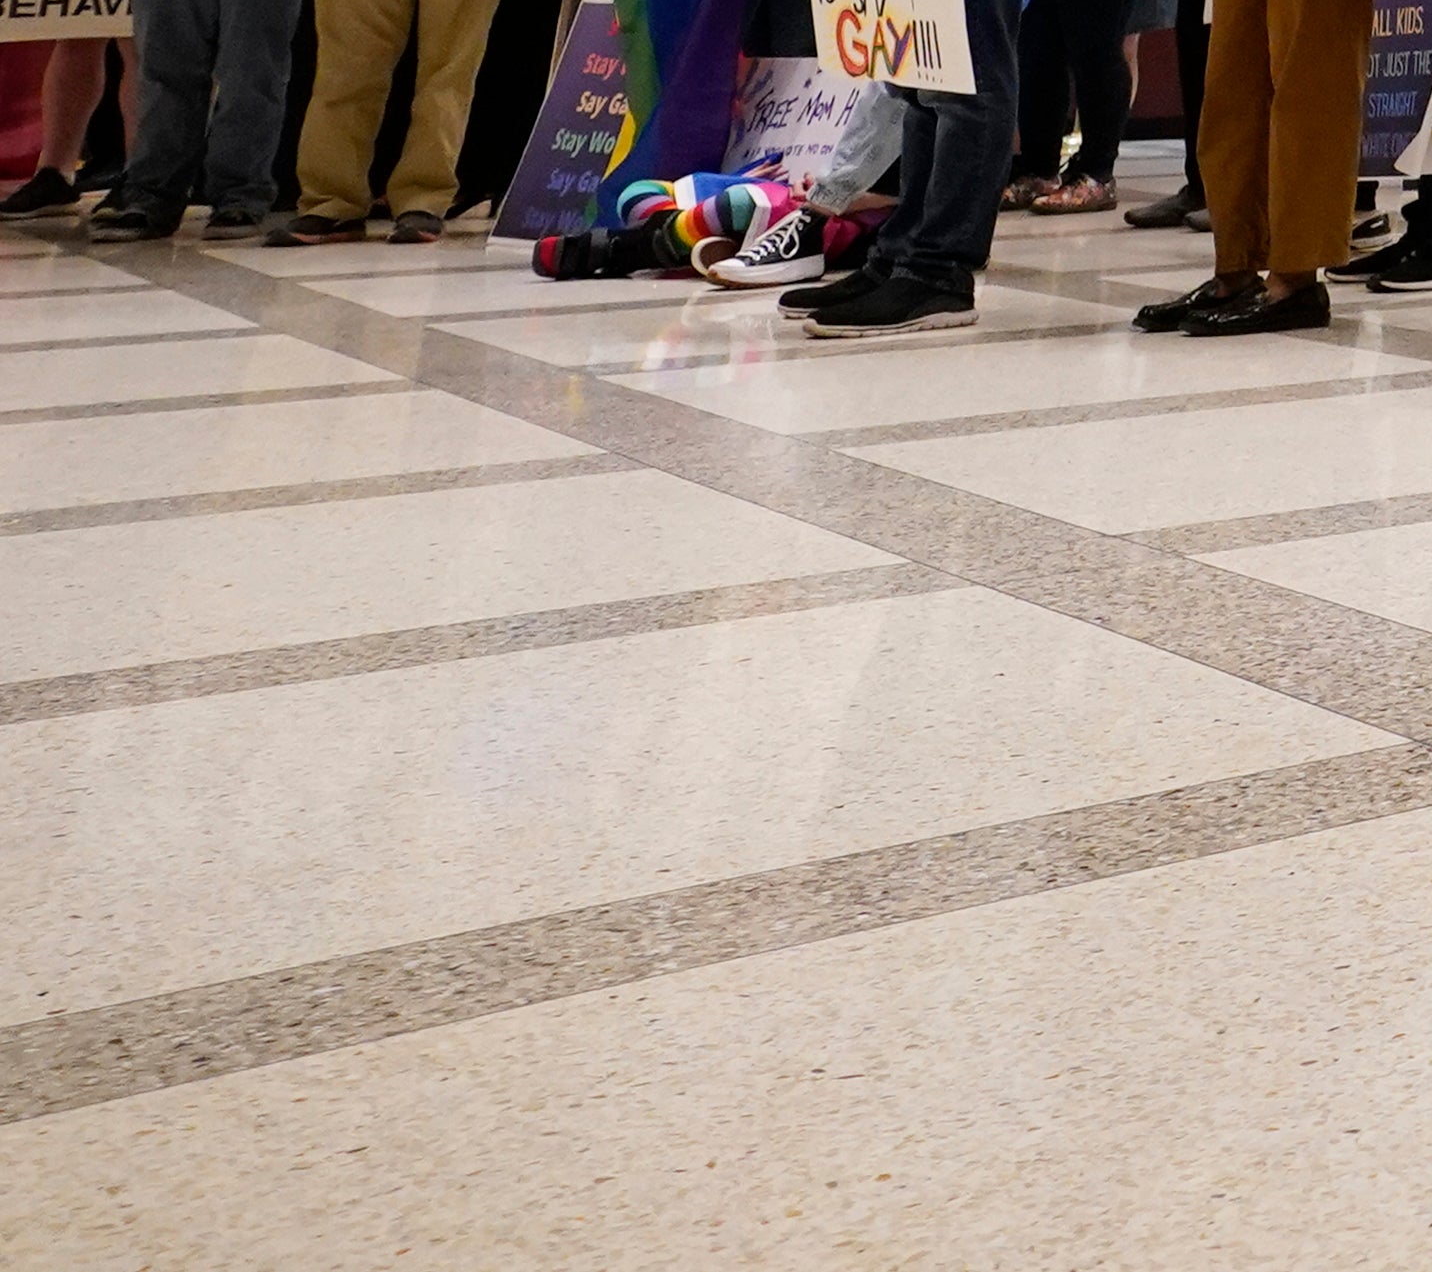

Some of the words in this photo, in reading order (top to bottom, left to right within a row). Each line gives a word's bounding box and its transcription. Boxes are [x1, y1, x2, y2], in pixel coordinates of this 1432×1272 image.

[1372, 9, 1392, 37] ALL
[583, 53, 620, 81] Stay
[1383, 50, 1411, 77] JUST
[576, 91, 607, 119] Say
[747, 88, 799, 133] FREE
[552, 128, 588, 158] Stay
